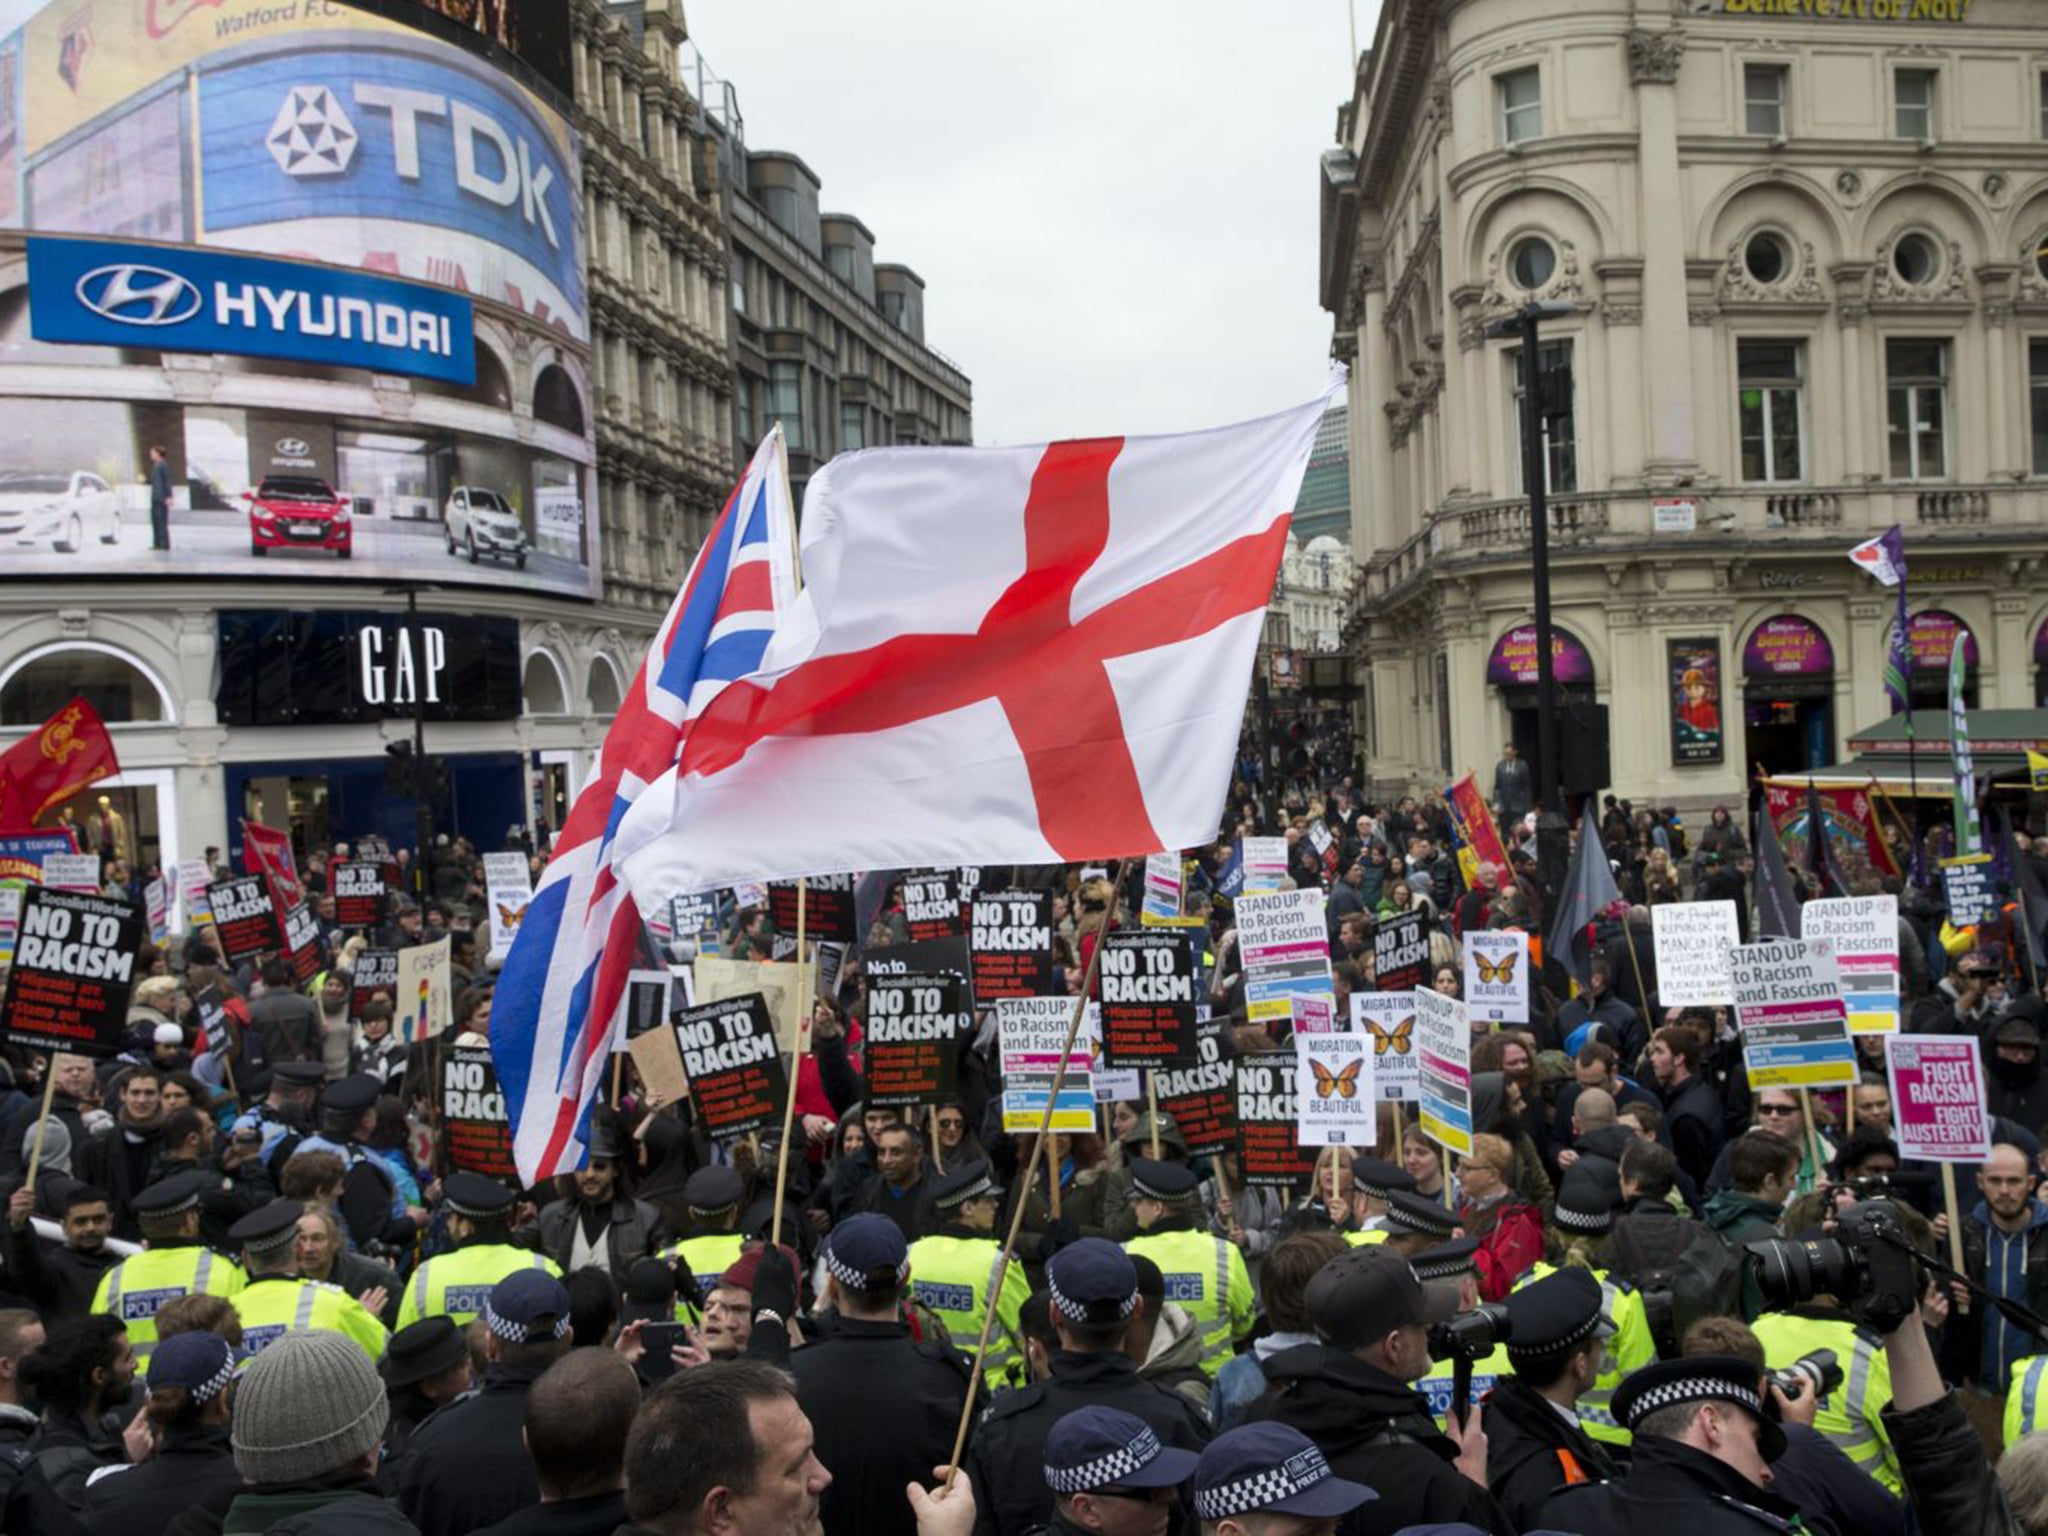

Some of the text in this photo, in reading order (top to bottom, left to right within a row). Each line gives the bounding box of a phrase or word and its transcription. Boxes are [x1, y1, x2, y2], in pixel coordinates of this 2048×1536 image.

[215, 3, 297, 37] Watford
[1872, 0, 1900, 19] or
[354, 83, 560, 249] TDK
[215, 282, 451, 357] HYUNDAI
[361, 626, 444, 703] GAP
[336, 868, 376, 883] NO TO
[961, 866, 980, 886] TO
[209, 884, 259, 908] NO TO
[336, 882, 384, 896] RACISM
[904, 882, 946, 903] NO TO
[213, 896, 273, 924] RACISM
[906, 899, 959, 922] RACISM
[972, 902, 1037, 926] NO TO
[1237, 893, 1301, 913] STAND UP
[1806, 900, 1873, 919] STAND UP
[23, 904, 120, 947] NO TO
[1240, 911, 1305, 929] to Racism
[1805, 919, 1875, 935] to Racism
[972, 926, 1050, 951] RACISM
[1242, 925, 1323, 945] and Fascism
[1375, 930, 1396, 954] NO
[1400, 922, 1419, 945] TO
[1472, 936, 1517, 947] MIGRATION
[1837, 936, 1894, 950] Fascism
[16, 935, 134, 982] RACISM
[357, 958, 396, 972] NO TO
[1101, 948, 1174, 975] NO TO
[1376, 939, 1428, 975] RACISM
[1730, 943, 1807, 965] STAND UP
[1733, 964, 1813, 984] to Racism
[1101, 975, 1191, 1002] RACISM
[1474, 984, 1517, 996] BEAUTIFUL
[1736, 985, 1767, 1002] and
[1771, 981, 1837, 1000] Fascism
[869, 988, 941, 1015] NO TO
[1001, 1000, 1067, 1016] STAND UP
[1361, 998, 1414, 1010] MIGRATION
[676, 1011, 753, 1051] NO TO
[868, 1014, 956, 1042] RACISM
[1002, 1018, 1069, 1033] to Racism
[1003, 1035, 1029, 1050] and
[1309, 1040, 1362, 1052] MIGRATION
[684, 1032, 776, 1077] RACISM
[445, 1062, 484, 1091] NO
[1155, 1059, 1234, 1098] RACISM
[1237, 1067, 1299, 1094] NO T
[1922, 1060, 1971, 1083] FIGHT
[1909, 1082, 1976, 1104] RACISM
[445, 1091, 508, 1120] RACI
[1310, 1100, 1363, 1113] BEAUTIFUL
[1934, 1105, 1979, 1124] FIGHT
[1902, 1123, 1984, 1143] AUSTERITY
[915, 1292, 971, 1310] POLICE
